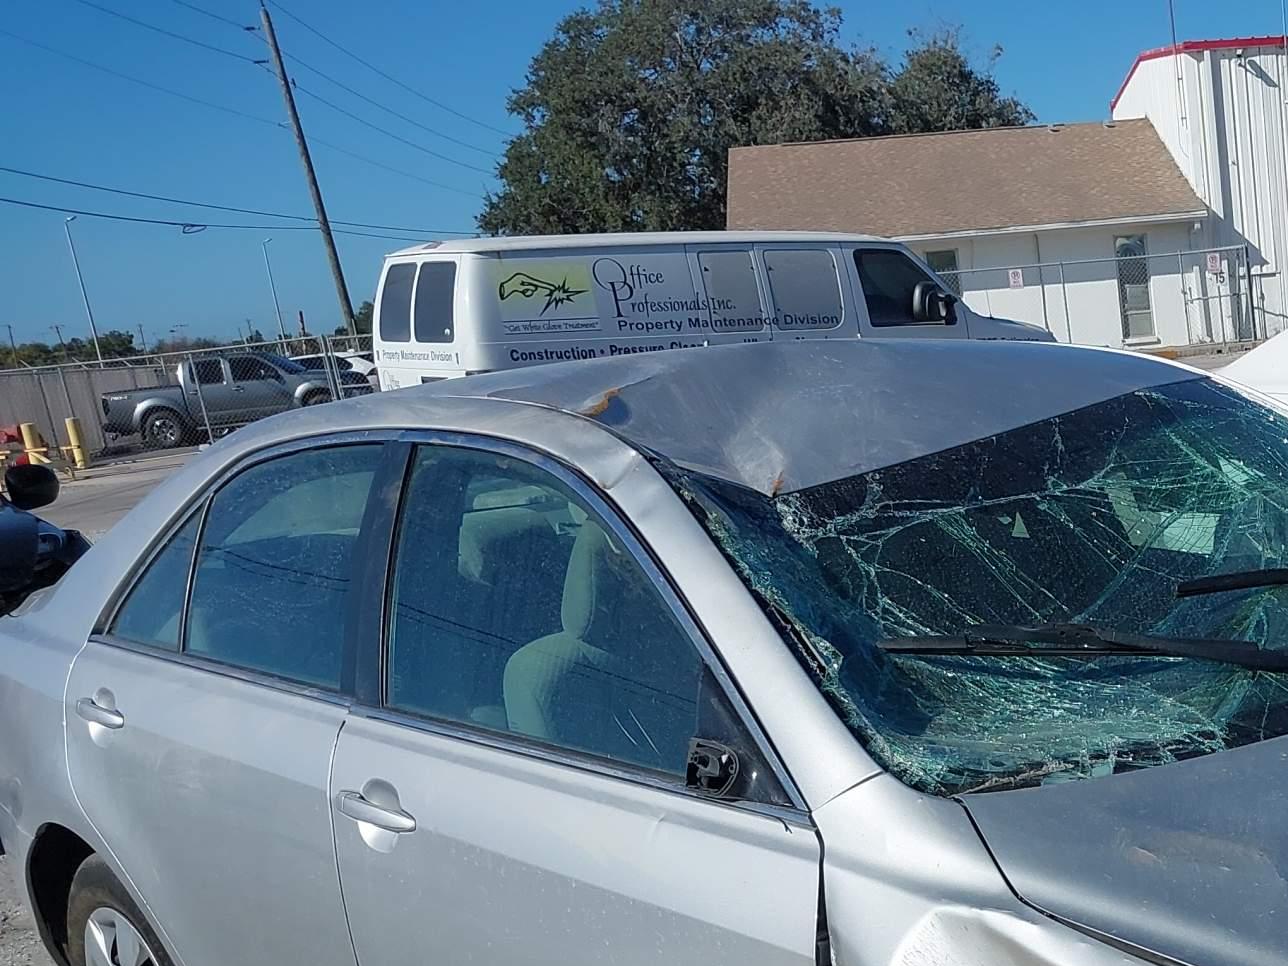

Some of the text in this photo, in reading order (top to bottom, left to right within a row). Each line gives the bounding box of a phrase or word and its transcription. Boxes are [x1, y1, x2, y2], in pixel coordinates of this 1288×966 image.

[592, 257, 664, 292] Office
[608, 281, 737, 318] Professionals Inc.
[617, 319, 683, 333] Property
[783, 314, 839, 326] Division
[430, 350, 453, 361] Division
[510, 347, 597, 362] Construction
